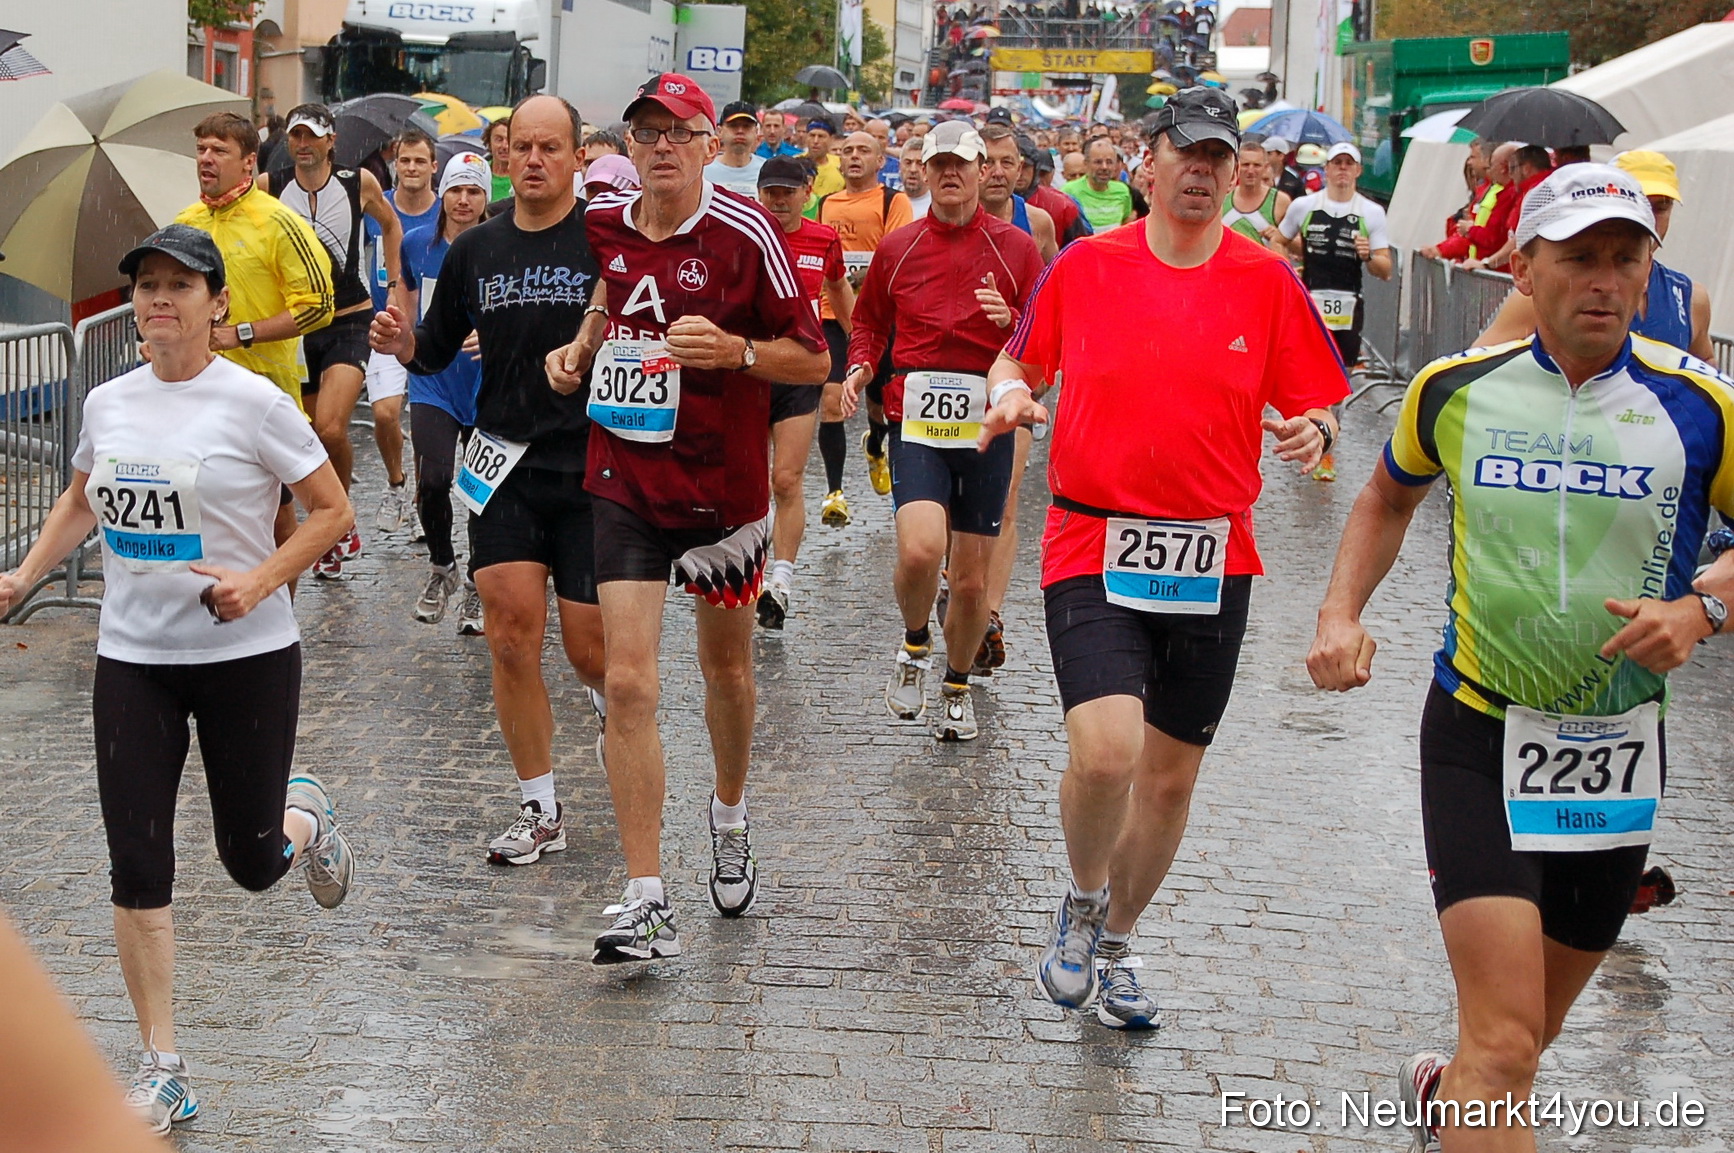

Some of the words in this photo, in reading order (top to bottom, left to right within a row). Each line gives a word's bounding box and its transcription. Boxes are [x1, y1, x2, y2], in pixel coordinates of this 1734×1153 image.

[388, 3, 475, 23] BOCK
[687, 46, 743, 72] BO
[1042, 54, 1098, 68] START
[798, 254, 824, 267] JURA
[523, 265, 592, 287] HiRo
[679, 269, 705, 287] FCN
[522, 286, 552, 298] Run
[620, 274, 667, 324] A
[1323, 299, 1342, 315] 58
[597, 365, 668, 405] 3023
[920, 391, 971, 421] 263
[611, 411, 646, 427] Ewald
[926, 425, 960, 438] Harald
[1485, 427, 1593, 457] TEAM
[116, 463, 160, 477] BOCK
[1474, 454, 1655, 500] BOCK
[97, 486, 185, 531] 3241
[116, 537, 176, 559] Angelika
[1117, 528, 1217, 574] 2570
[1149, 580, 1181, 597] Dirk
[1518, 741, 1645, 794] 2237
[1556, 808, 1608, 829] Hans
